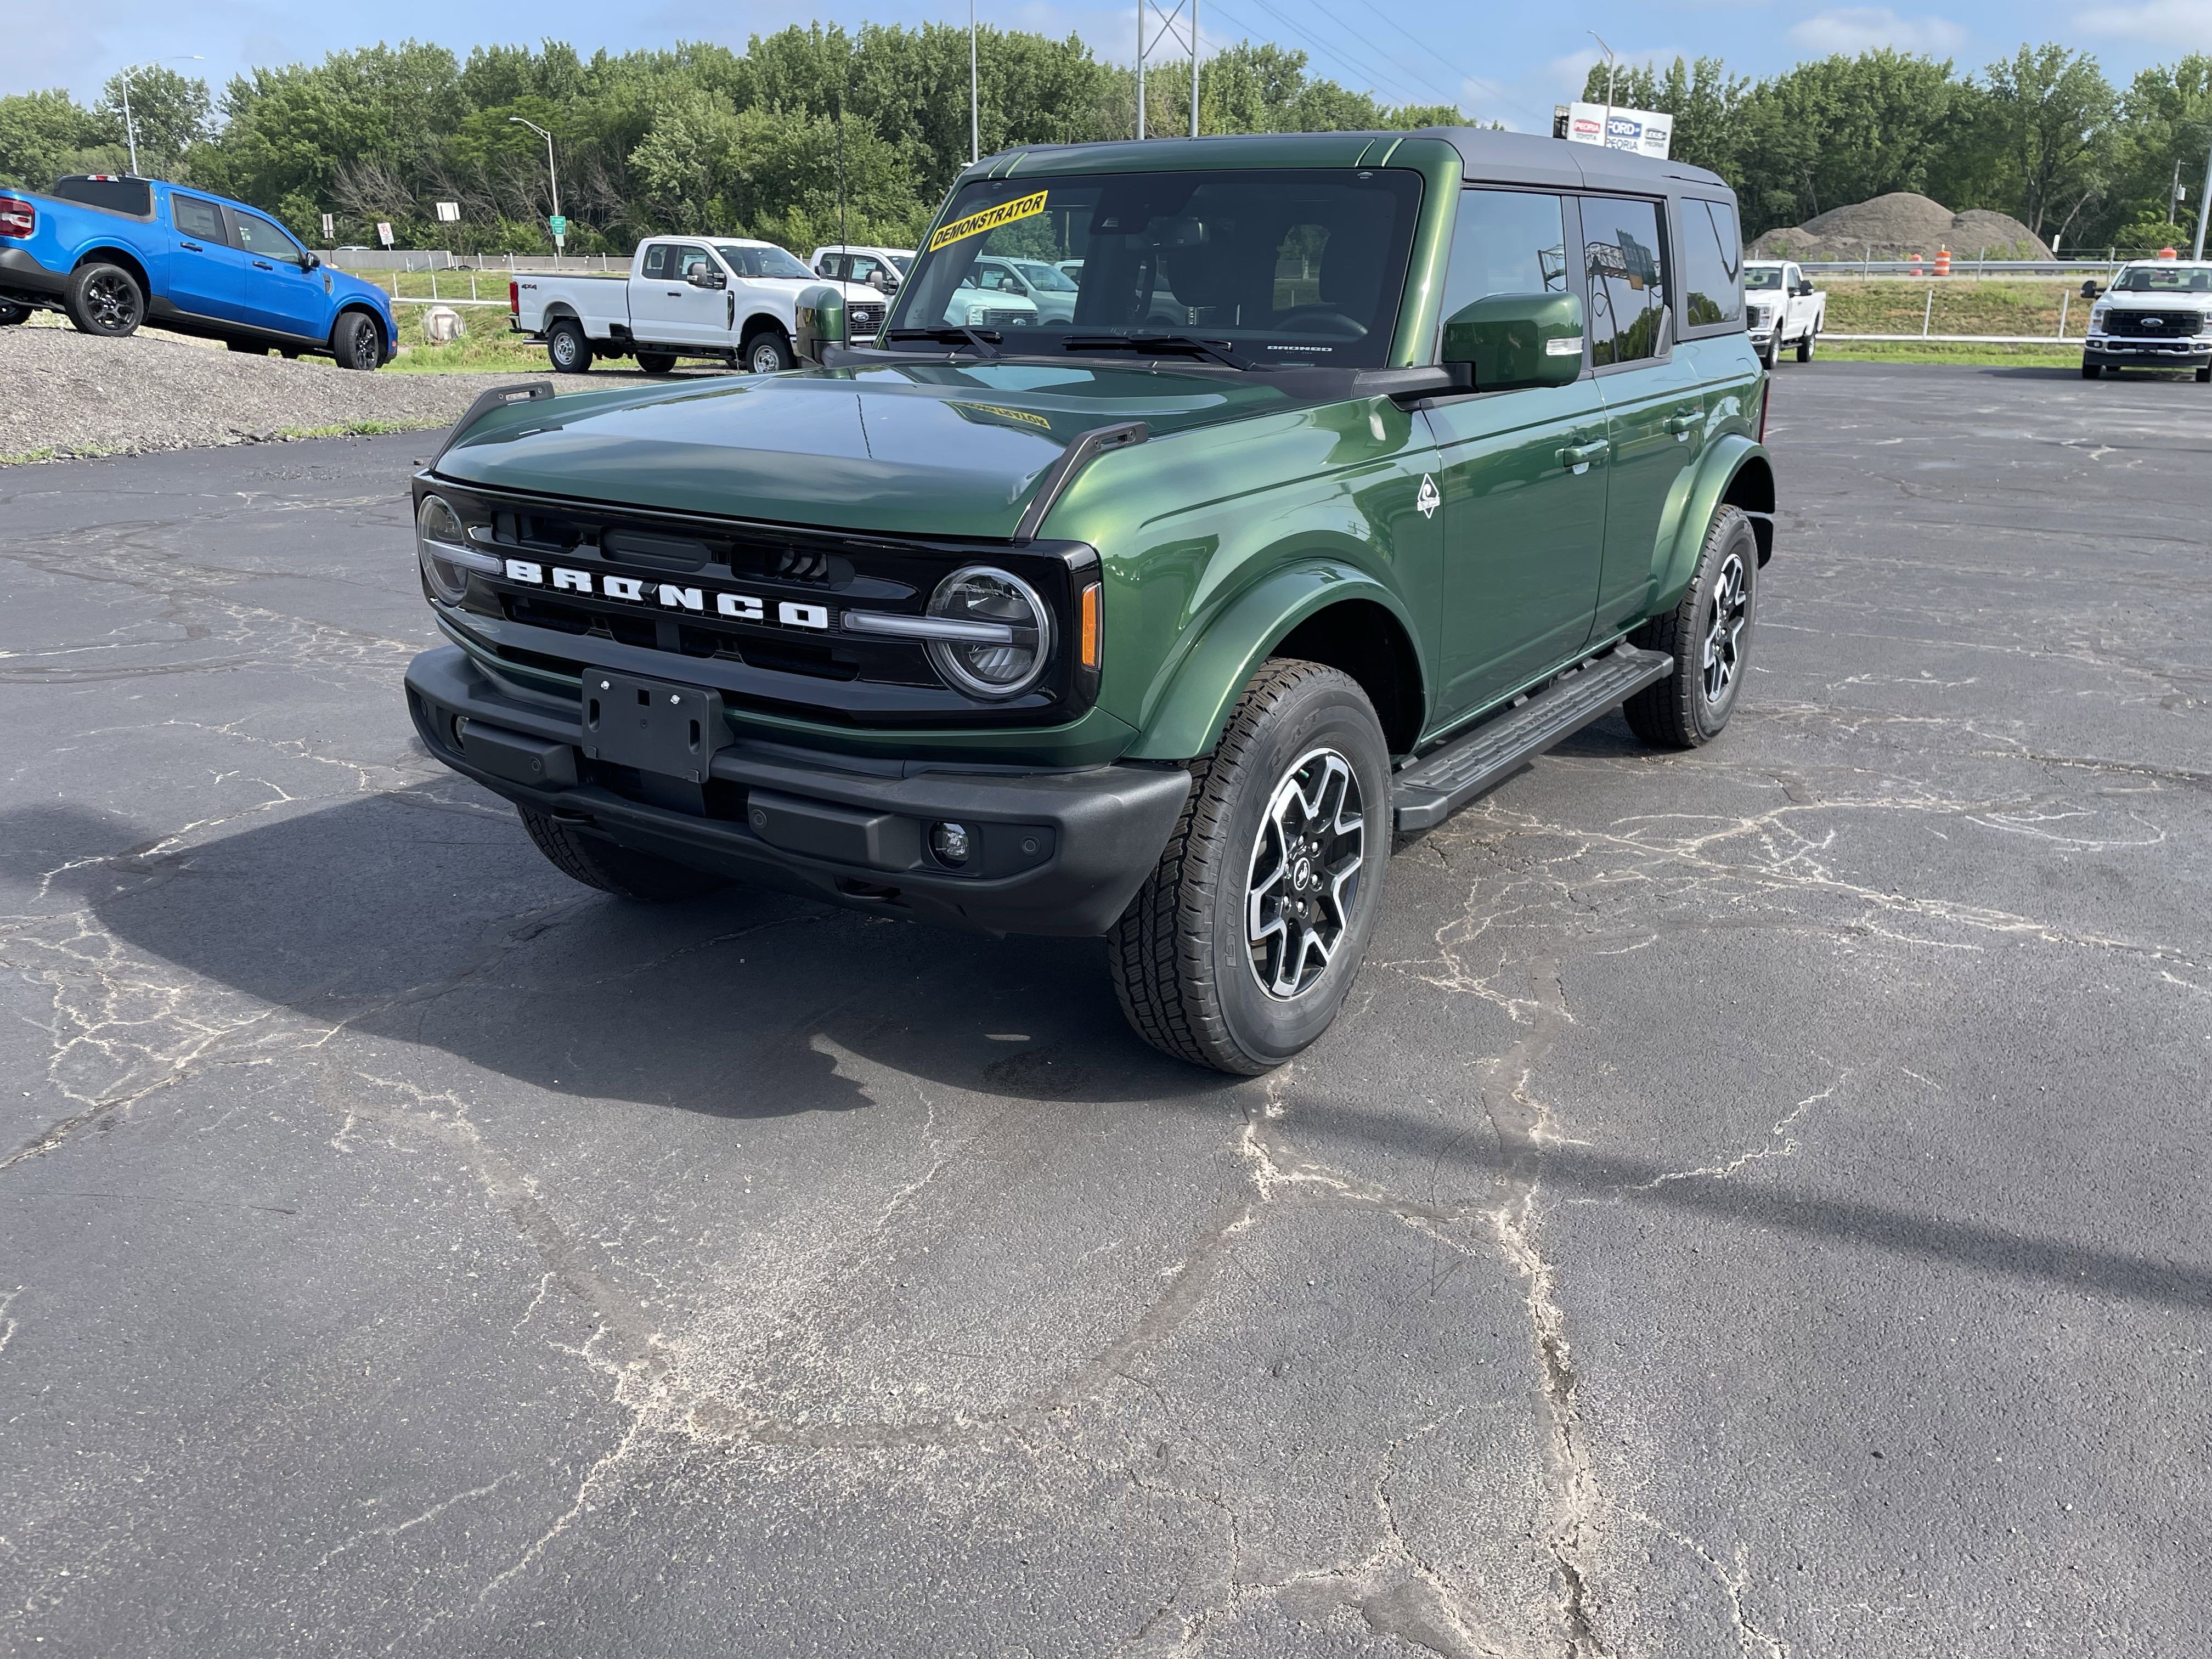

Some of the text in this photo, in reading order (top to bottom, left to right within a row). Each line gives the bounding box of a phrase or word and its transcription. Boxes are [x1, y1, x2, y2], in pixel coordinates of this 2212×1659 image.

[1608, 121, 1635, 134] FORD
[1607, 138, 1638, 150] PEORIA
[933, 195, 1044, 247] DEMONSTRATOR
[505, 558, 828, 629] BRONCO
